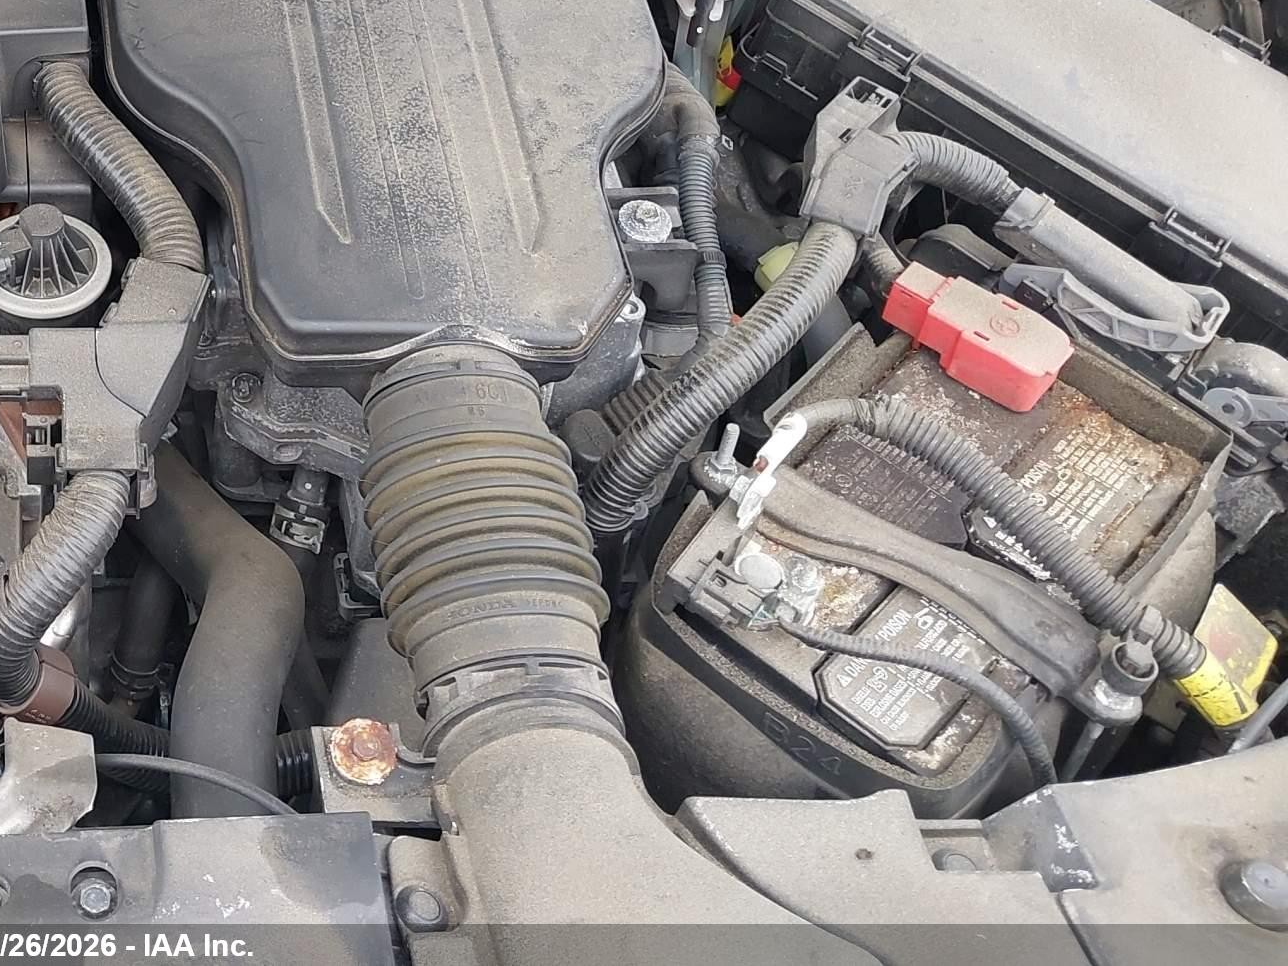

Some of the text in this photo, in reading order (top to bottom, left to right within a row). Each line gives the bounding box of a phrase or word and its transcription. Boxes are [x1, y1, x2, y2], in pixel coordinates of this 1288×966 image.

[1021, 459, 1053, 489] POISON
[878, 609, 912, 641] POISON
[762, 712, 842, 776] B24
